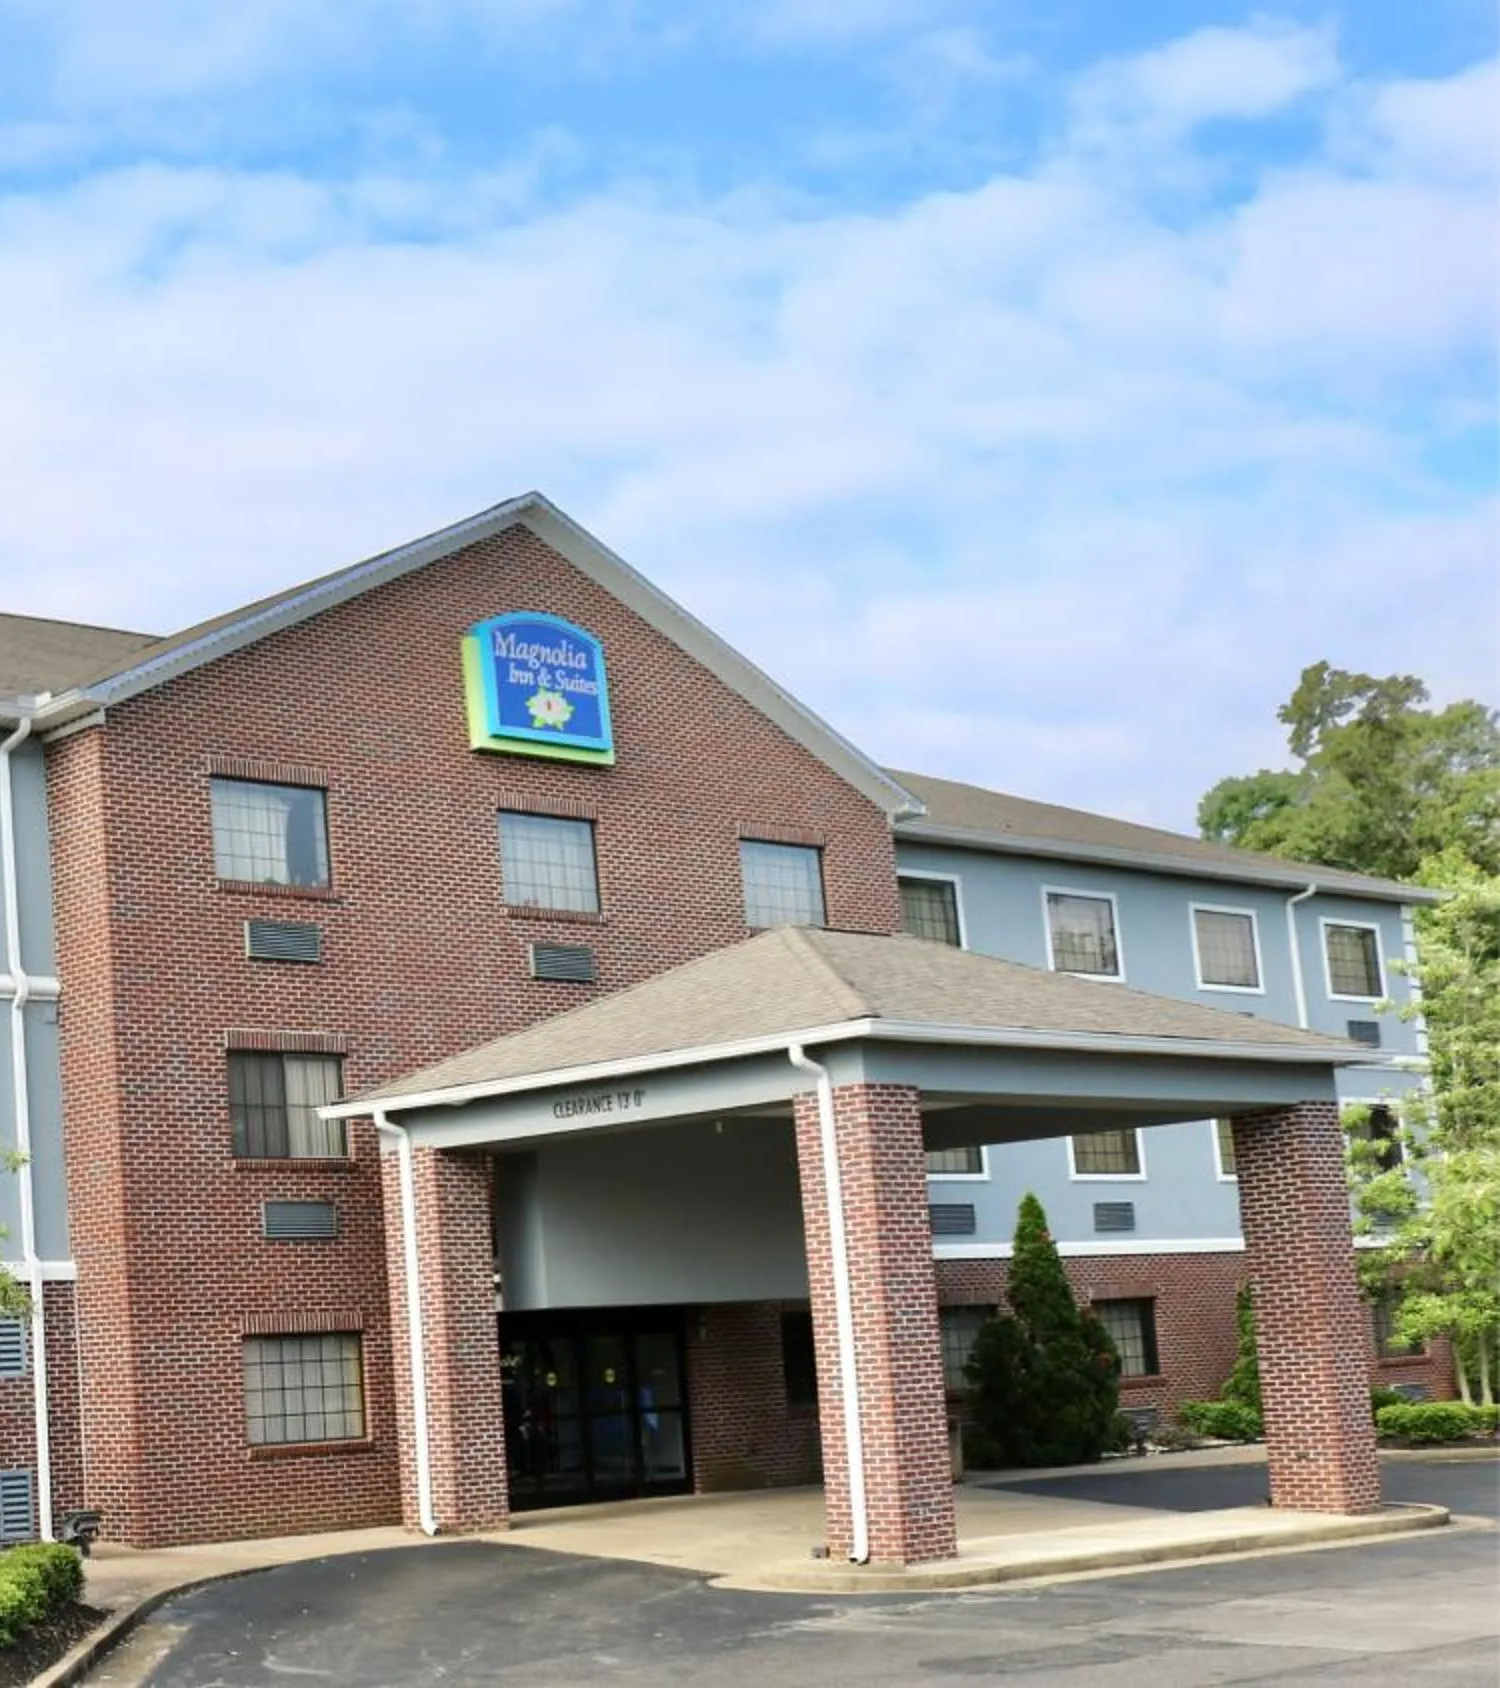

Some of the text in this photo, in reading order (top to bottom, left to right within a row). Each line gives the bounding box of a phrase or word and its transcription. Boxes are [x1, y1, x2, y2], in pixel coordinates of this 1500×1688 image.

[495, 631, 587, 669] Magnolia
[508, 662, 598, 695] Inn & Suites
[553, 1094, 613, 1118] CLEARANCE
